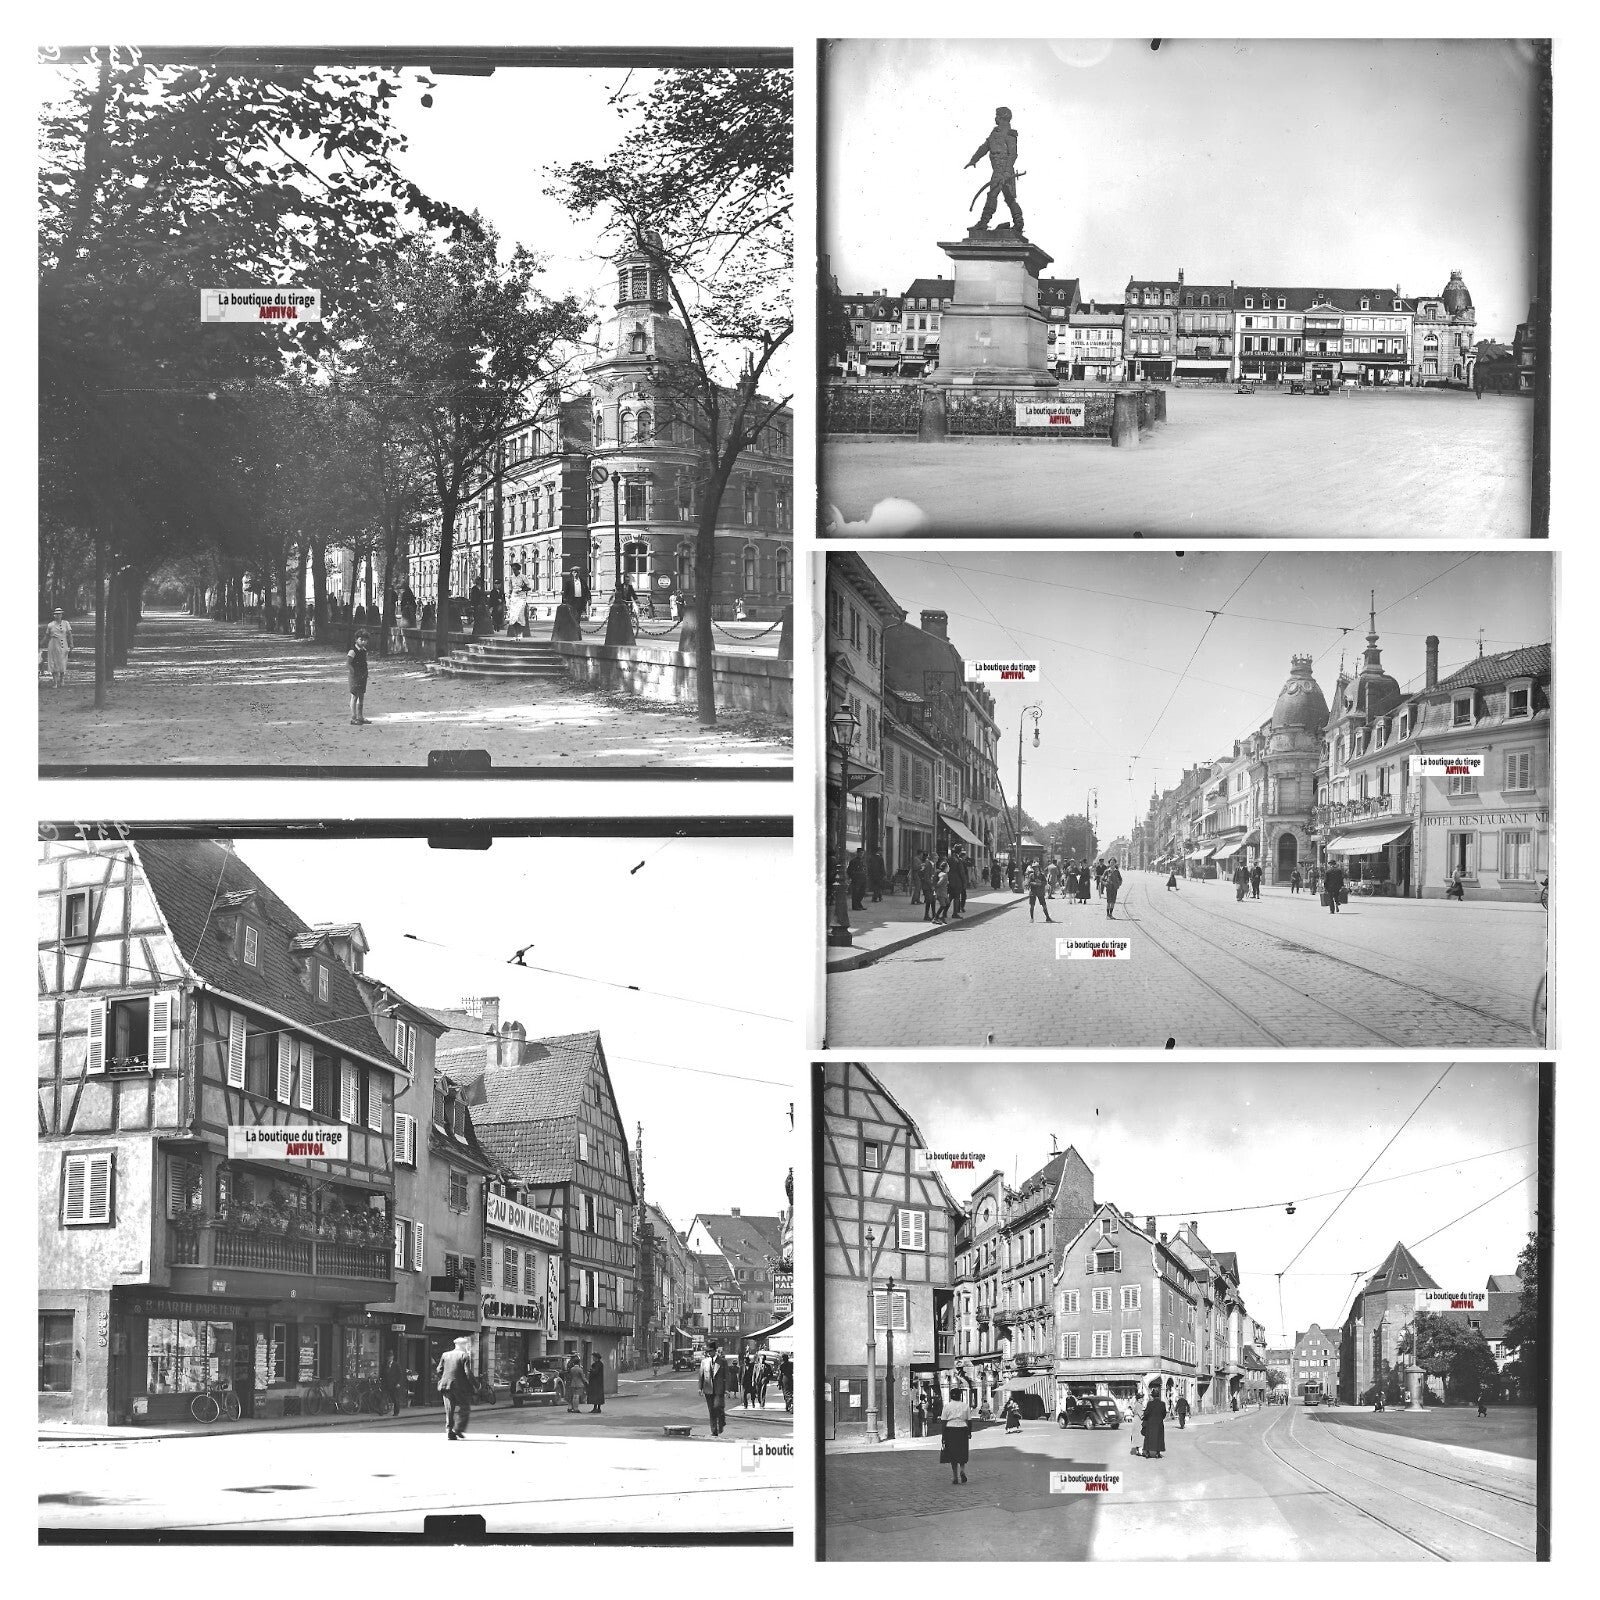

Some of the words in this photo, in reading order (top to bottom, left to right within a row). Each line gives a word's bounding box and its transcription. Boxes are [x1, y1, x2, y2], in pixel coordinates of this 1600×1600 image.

[1424, 816, 1455, 826] HOTEL
[1460, 813, 1528, 826] RESTAURANT
[494, 1200, 506, 1222] AU
[508, 1205, 526, 1230] BON
[528, 1212, 555, 1238] NEGRE
